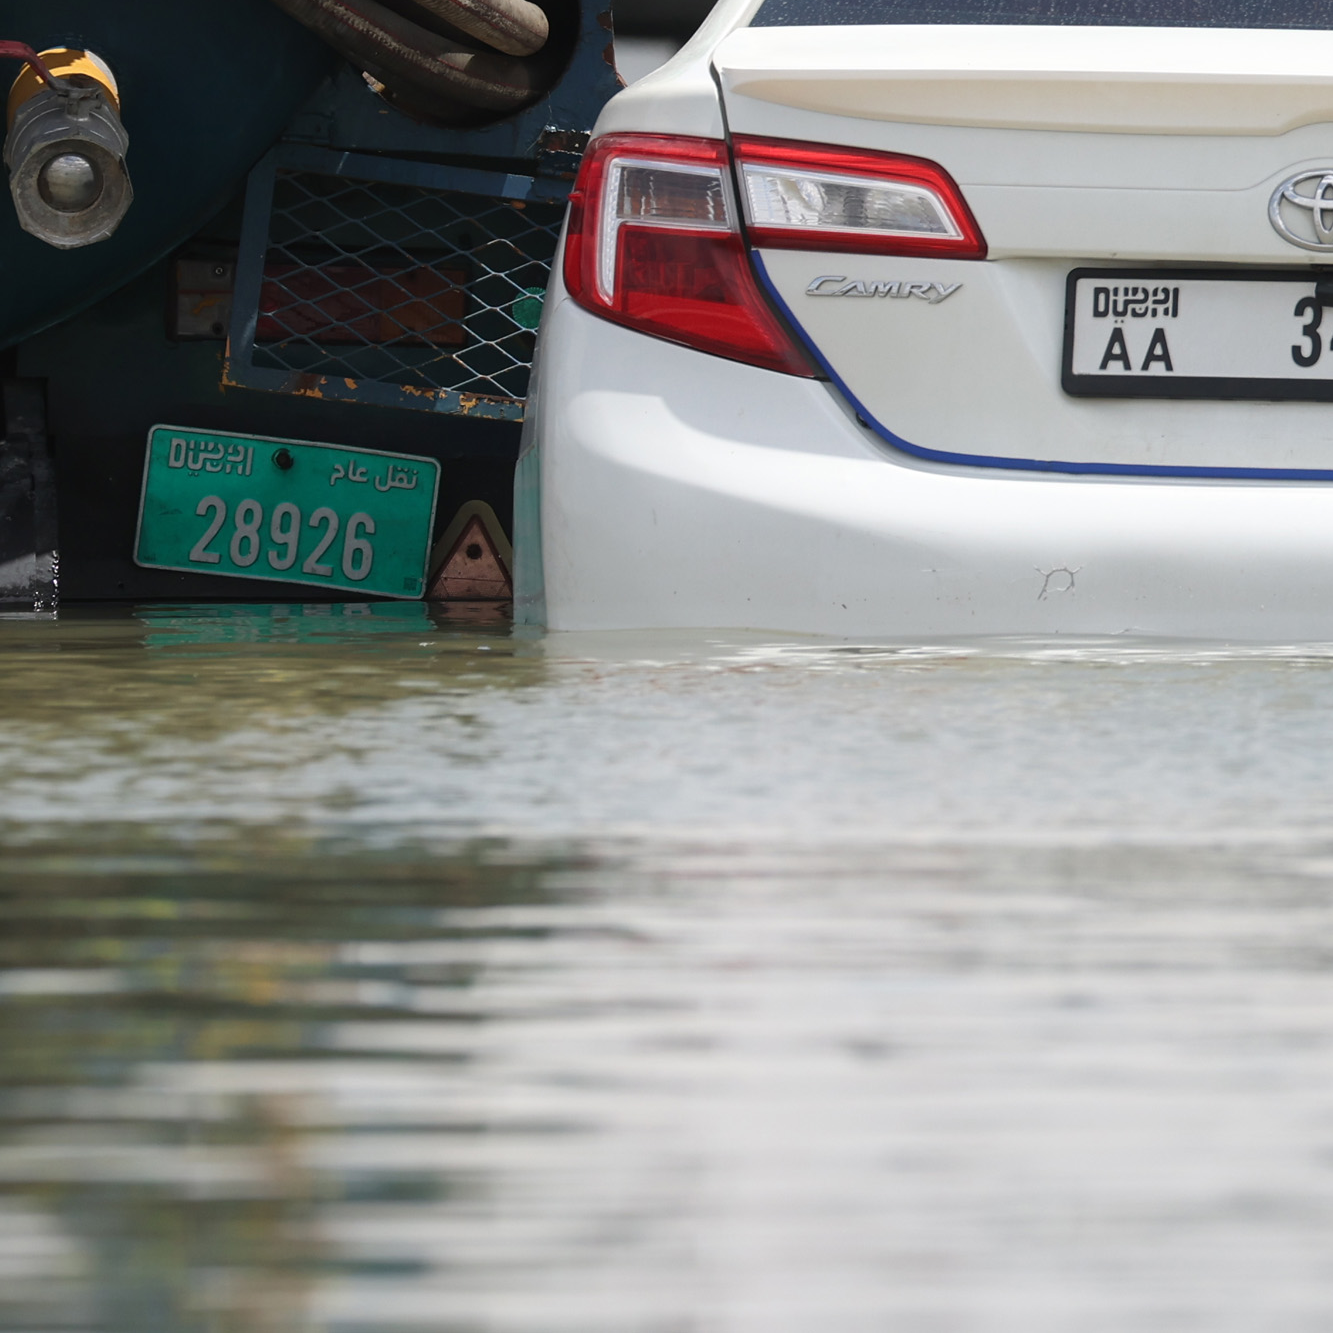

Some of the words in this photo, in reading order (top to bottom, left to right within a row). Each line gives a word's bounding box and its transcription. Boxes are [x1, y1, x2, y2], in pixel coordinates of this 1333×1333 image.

[805, 275, 964, 305] CAMRY
[1099, 327, 1174, 372] AA
[329, 459, 369, 486] عام
[375, 464, 419, 492] نقل
[188, 495, 376, 582] 28926
